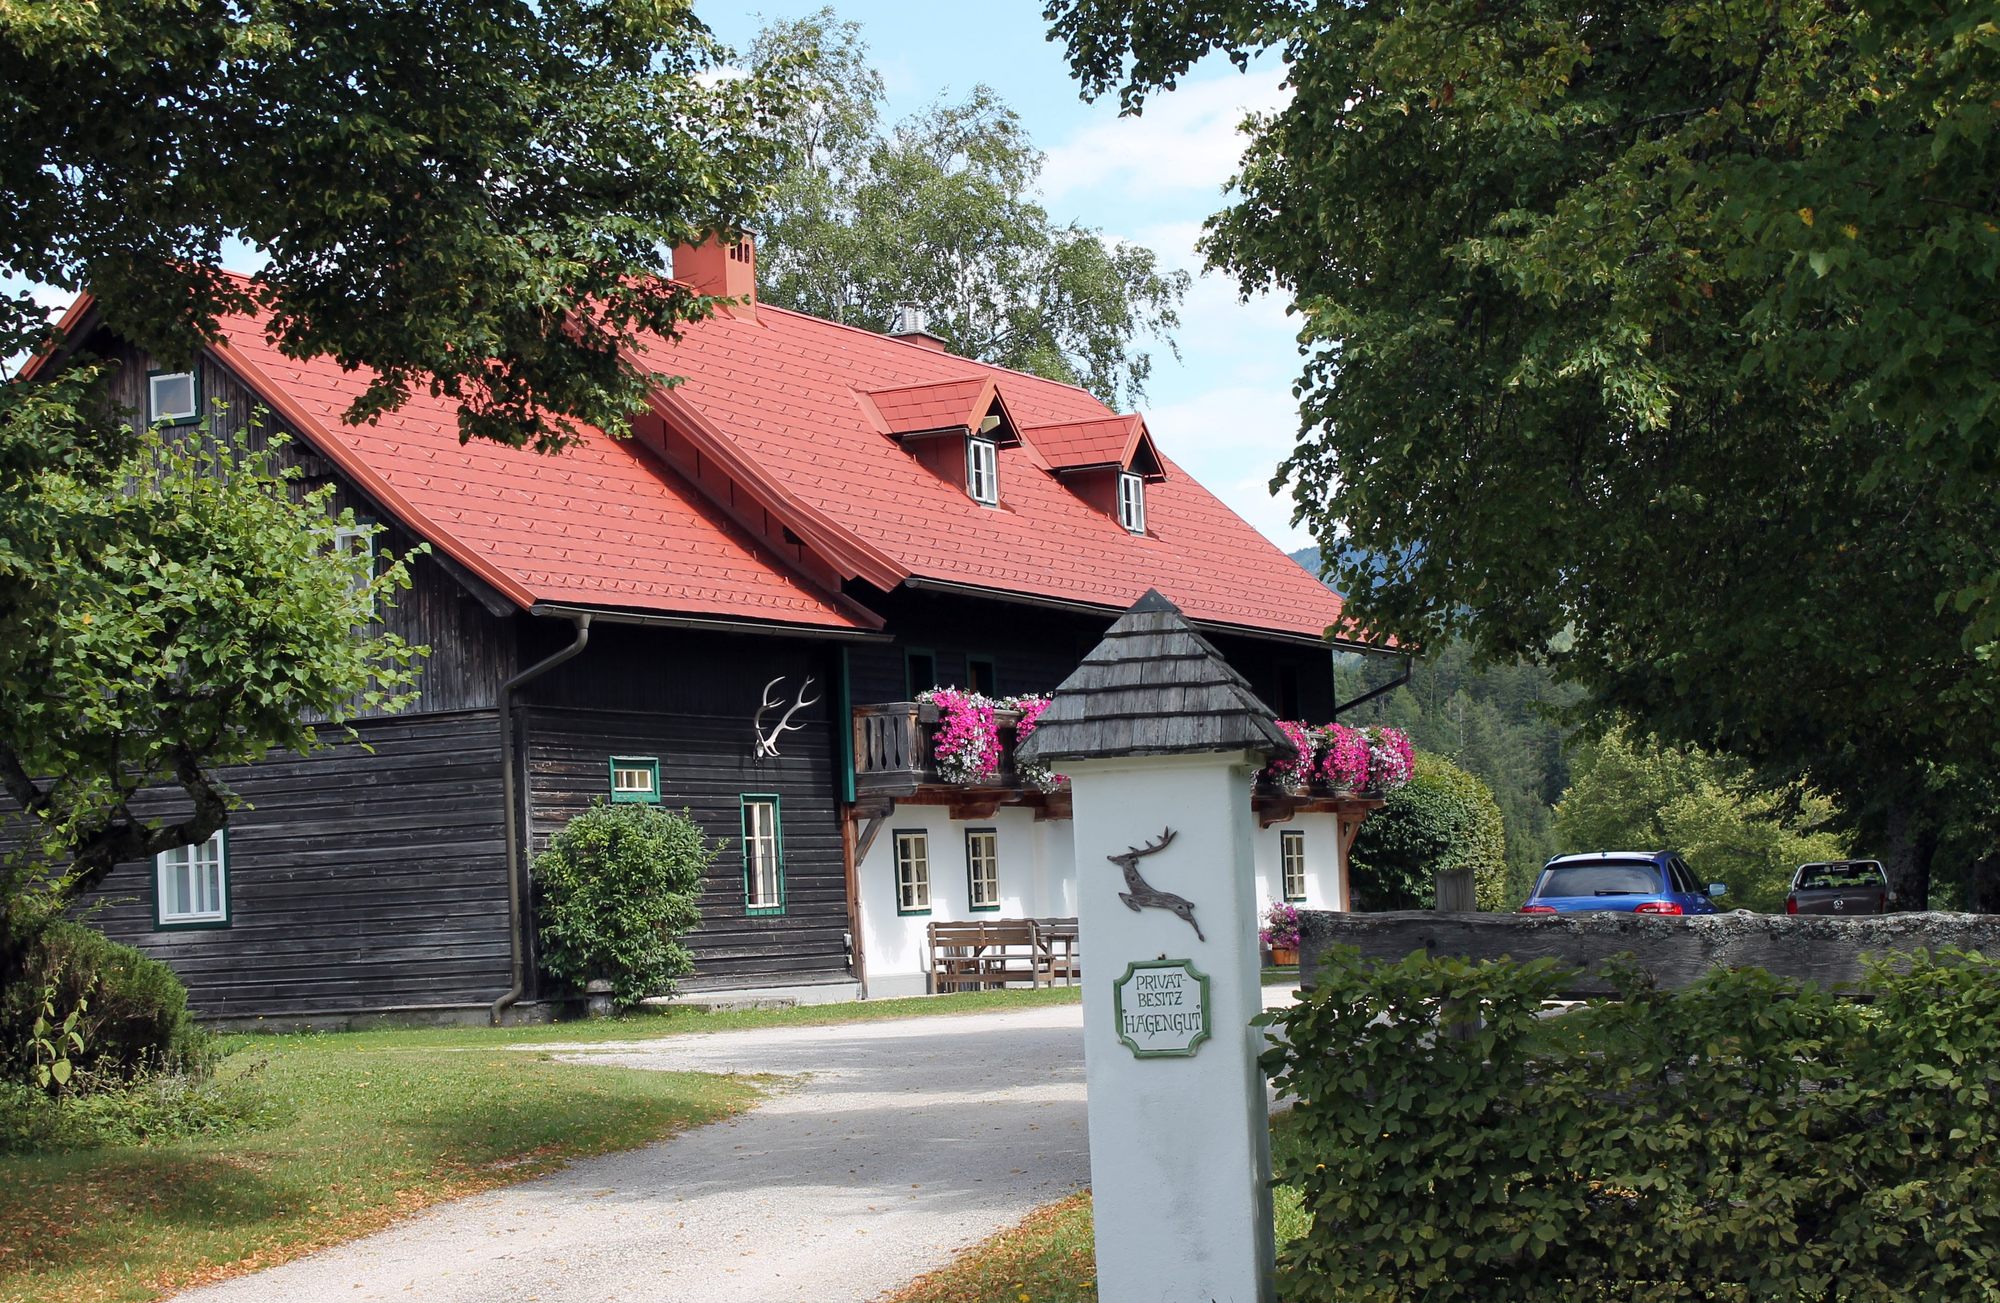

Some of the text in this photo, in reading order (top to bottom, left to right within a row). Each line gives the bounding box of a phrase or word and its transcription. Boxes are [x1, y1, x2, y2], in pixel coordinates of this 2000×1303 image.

[1136, 973, 1187, 991] PRIVAT-
[1138, 991, 1183, 1007] BESITZ
[1124, 1012, 1200, 1039] HAGENGUT
